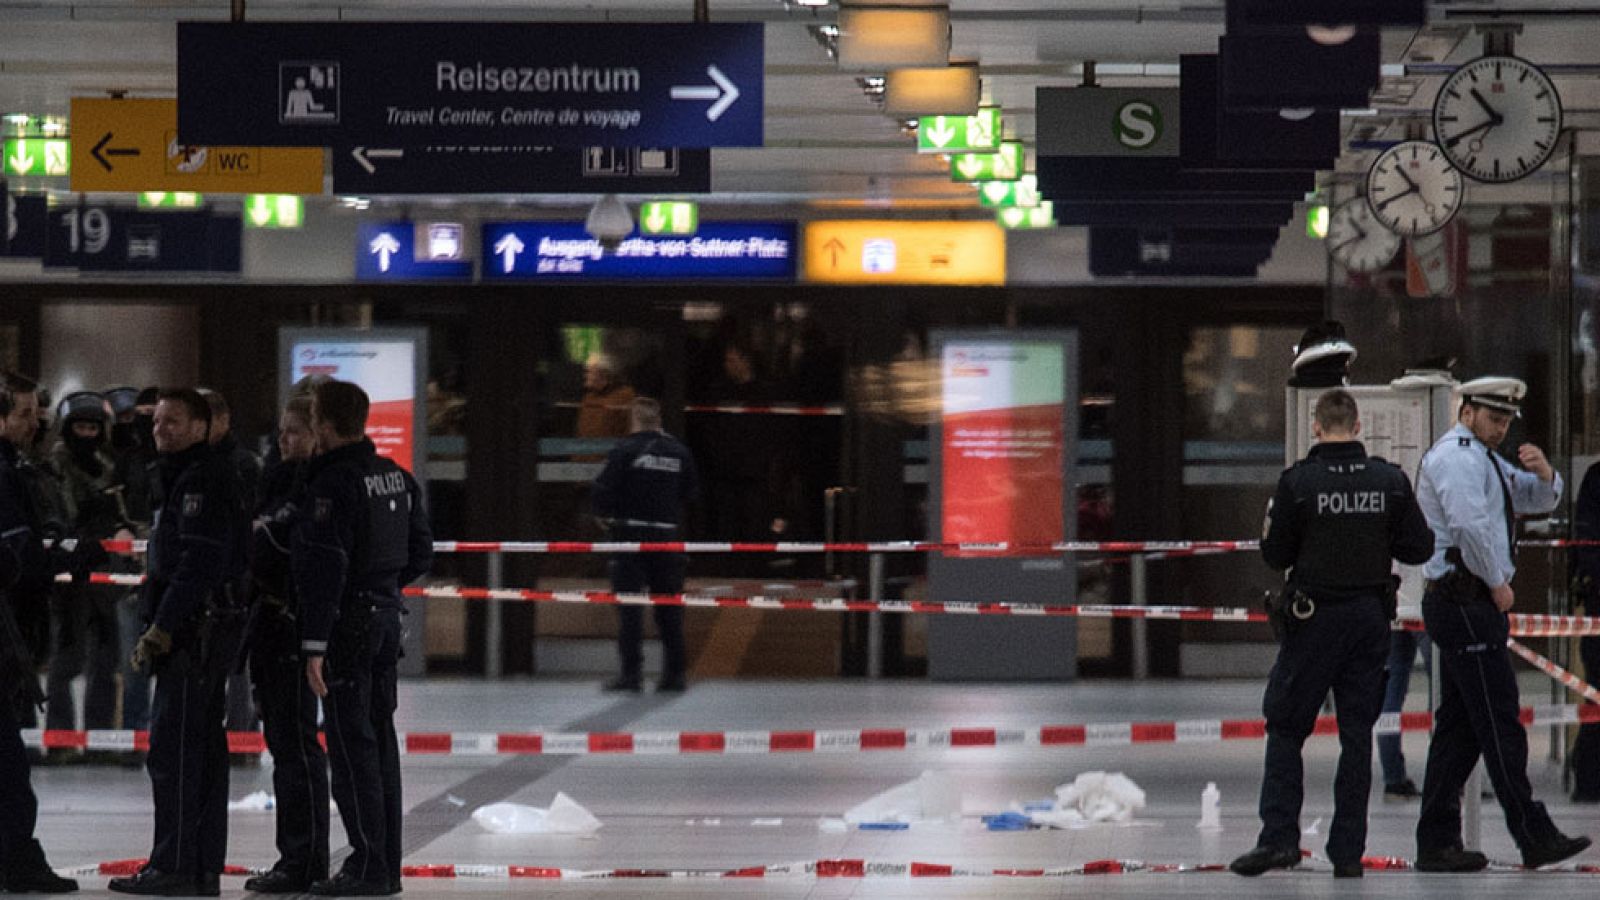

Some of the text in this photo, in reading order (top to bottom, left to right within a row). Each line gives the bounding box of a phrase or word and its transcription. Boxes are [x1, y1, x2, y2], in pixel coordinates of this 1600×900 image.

[436, 61, 641, 92] Reisezentrum
[386, 107, 641, 129] Travel Center, Centre de voyage
[1120, 102, 1155, 147] S
[218, 153, 250, 171] WC
[61, 208, 110, 253] 19
[363, 471, 406, 498] POLIZEI
[1318, 491, 1385, 514] POLIZEI
